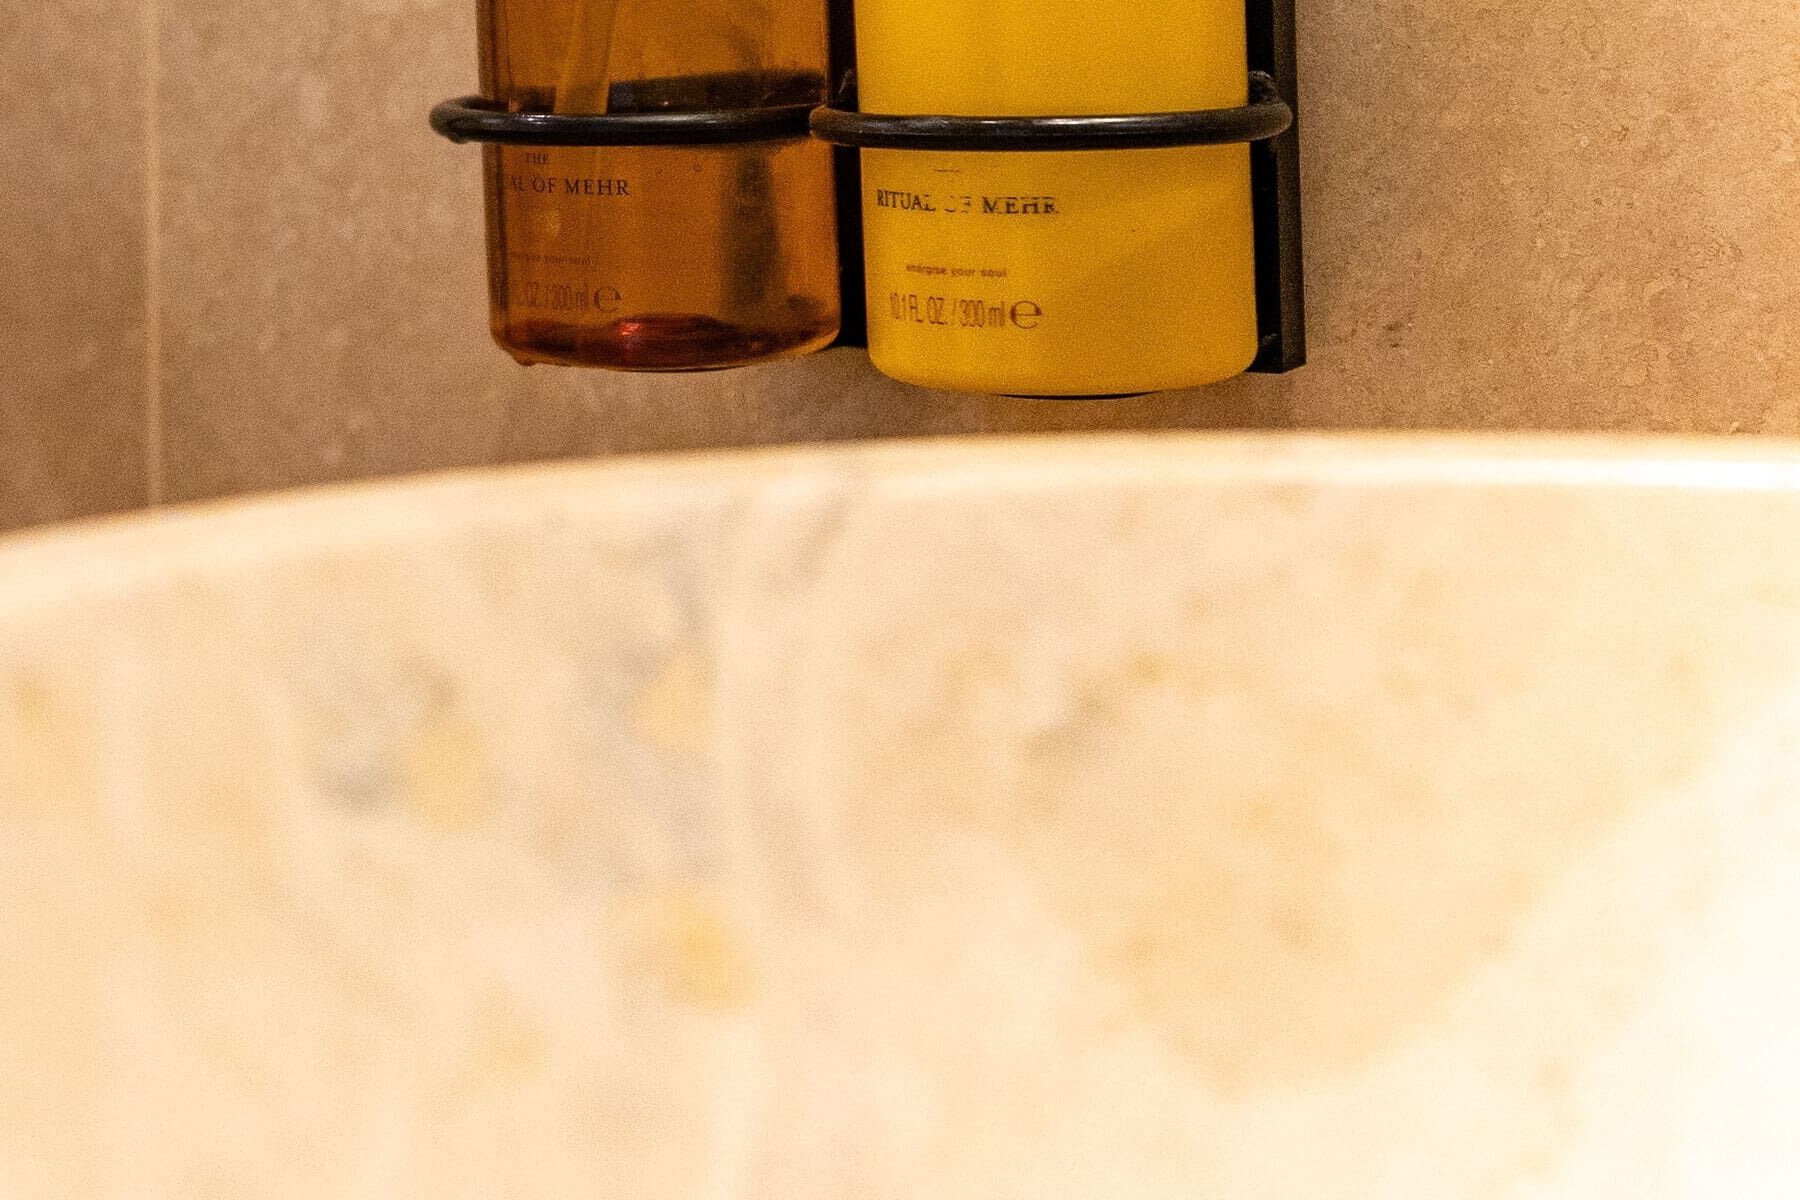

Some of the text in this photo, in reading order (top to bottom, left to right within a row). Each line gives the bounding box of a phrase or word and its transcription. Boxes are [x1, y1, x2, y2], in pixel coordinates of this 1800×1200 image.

[532, 177, 557, 194] OF
[565, 178, 631, 196] MEHR
[877, 188, 937, 213] RITUAL
[982, 196, 1060, 214] MEHR
